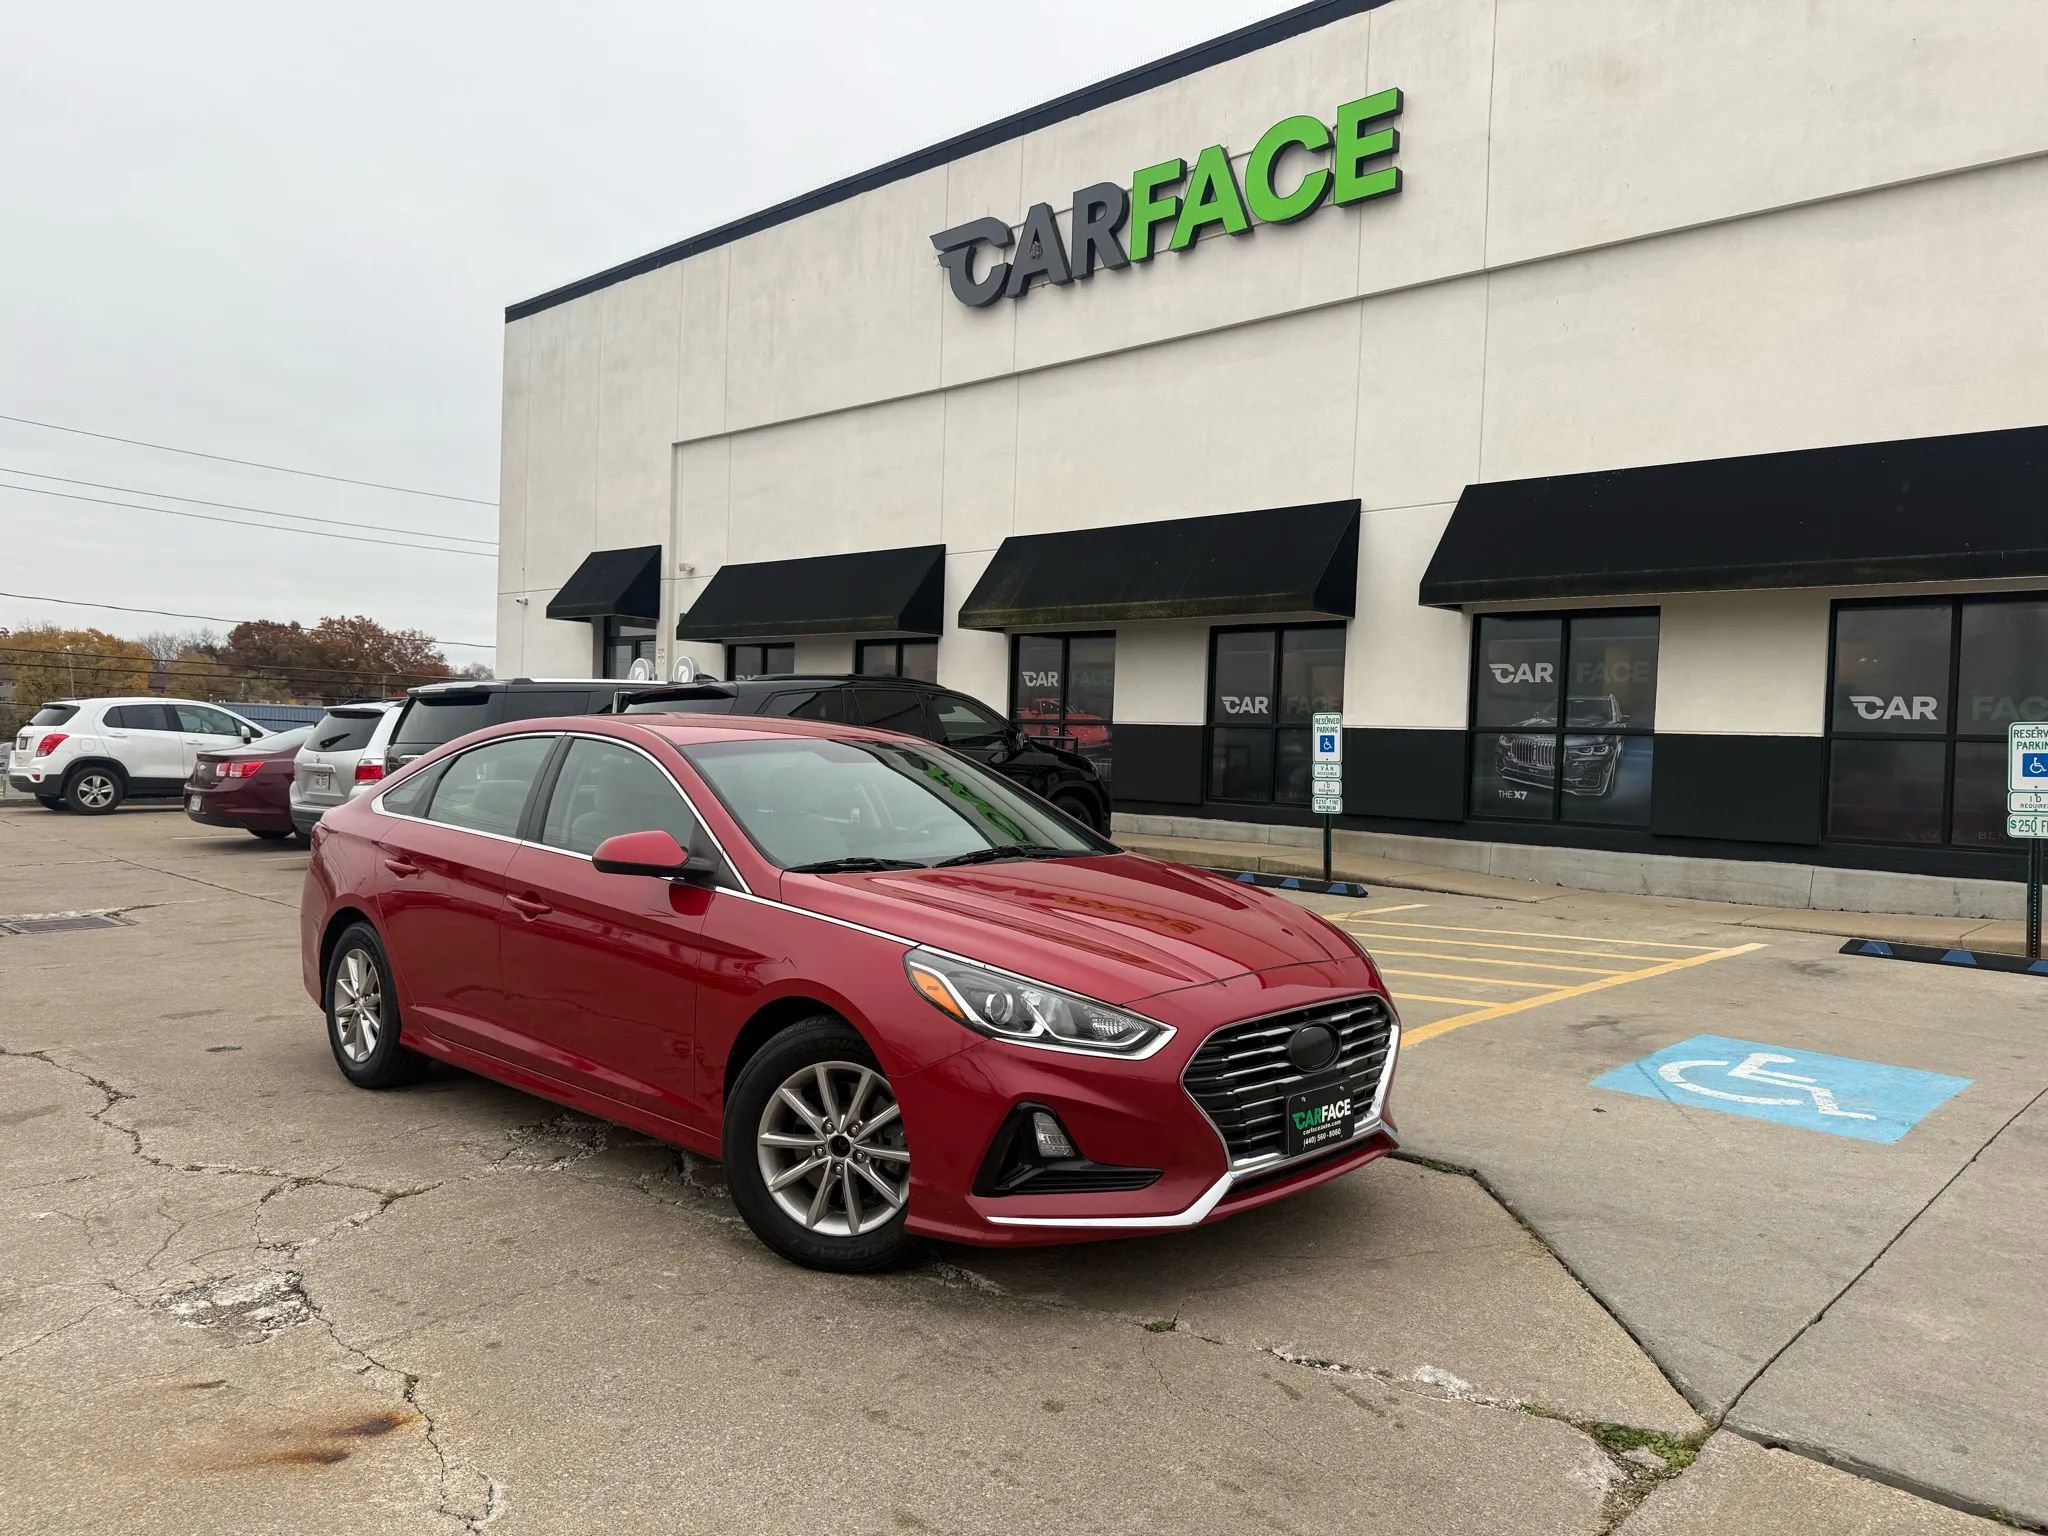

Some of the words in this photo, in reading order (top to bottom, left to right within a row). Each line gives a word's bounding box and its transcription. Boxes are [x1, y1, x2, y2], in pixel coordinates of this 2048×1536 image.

[930, 87, 1403, 307] CARFACE
[1022, 671, 1059, 687] CAR
[1489, 663, 1554, 684] CAR
[1576, 662, 1648, 683] FACE
[1221, 696, 1269, 714] CAR
[1849, 696, 1938, 720] CAR
[1315, 717, 1340, 725] RESERVED
[1316, 726, 1339, 734] PARKING
[1514, 790, 1528, 800] X7
[1292, 1099, 1351, 1130] CARFACE
